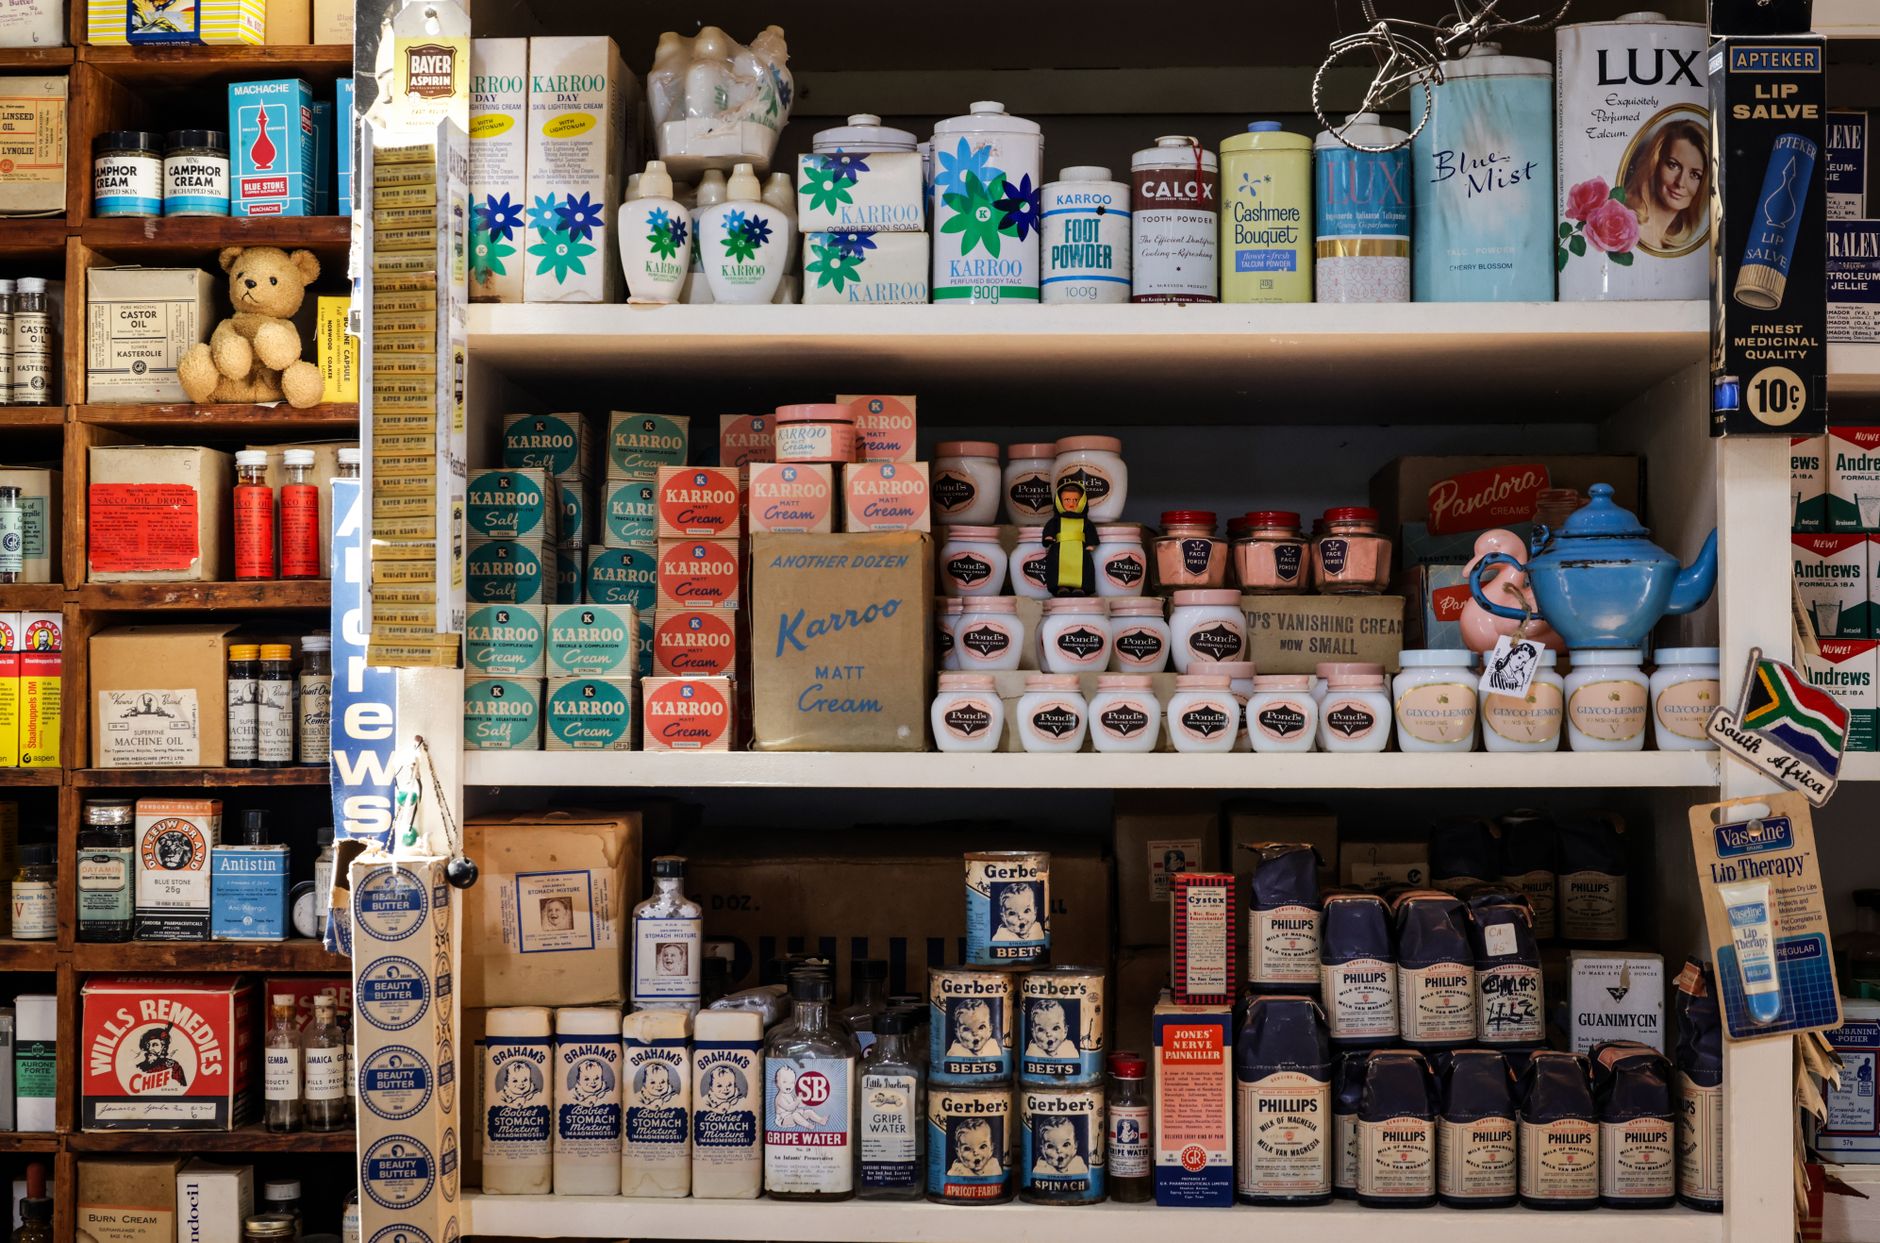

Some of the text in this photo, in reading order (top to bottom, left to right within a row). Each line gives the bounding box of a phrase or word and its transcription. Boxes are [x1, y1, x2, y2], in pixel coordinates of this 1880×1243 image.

[410, 55, 451, 74] BAYER
[1736, 52, 1815, 67] APTEKER
[1596, 48, 1704, 88] LUX
[234, 82, 289, 95] MACHACHE
[410, 76, 450, 86] ASPIRIN
[532, 74, 606, 94] KARROO
[557, 93, 579, 102] DAY
[1755, 83, 1799, 99] LIP
[1604, 92, 1659, 108] Exquisitely
[1590, 108, 1641, 124] Perfumed
[1732, 104, 1819, 120] SALVE
[2, 122, 15, 132] OIL
[558, 117, 575, 127] WITH
[1774, 135, 1818, 161] APTEKER
[168, 165, 222, 178] CAMPHOR
[1430, 150, 1511, 183] Blue
[174, 176, 214, 189] CREAM
[243, 181, 286, 191] BLUE STONE
[1327, 160, 1404, 206] LUX
[1467, 160, 1538, 199] Mist
[1141, 180, 1214, 200] CALOX
[1056, 194, 1112, 206] KARROO
[840, 204, 919, 225] KARROO
[1233, 200, 1300, 223] Cashmere
[1142, 215, 1213, 225] TOOTH POWDER
[1064, 218, 1102, 243] FOOT
[1234, 224, 1298, 248] Bouquet
[1051, 243, 1112, 270] POWDER
[1240, 259, 1292, 268] TALCUM POWDER
[644, 260, 683, 276] KARROO
[720, 264, 766, 277] KARROO
[950, 259, 1023, 277] KARROO
[1449, 262, 1513, 272] CHERRY BLOSSOM
[1831, 281, 1869, 291] JELLIE
[973, 285, 1000, 305] 90g
[119, 310, 158, 320] CASTOR
[130, 319, 148, 329] OIL
[1750, 324, 1804, 334] FINEST
[1733, 337, 1819, 347] MEDICINAL
[116, 349, 163, 359] KASTEROLIE
[1744, 349, 1808, 360] QUALITY
[754, 483, 827, 498] KARROO
[853, 480, 925, 496] KARROO
[133, 497, 152, 506] OIL
[156, 496, 189, 505] DROPS
[469, 491, 540, 506] KARROO
[665, 490, 736, 505] KARROO
[1428, 471, 1544, 530] Pandora
[863, 502, 915, 517] Cream
[1490, 505, 1531, 516] CREAMS
[676, 510, 725, 525] Cream
[1813, 539, 1839, 549] NEW!
[664, 561, 735, 576] KARROO
[770, 554, 909, 570] ANOTHER DOZEN
[952, 561, 986, 571] Pond's
[1794, 559, 1861, 579] Andrews
[674, 581, 723, 598] Cream
[775, 599, 903, 658] Karroo
[1277, 614, 1355, 634] VANISHING
[25, 619, 62, 648] LENNON
[467, 625, 539, 641] KARROO
[552, 626, 625, 642] KARROO
[969, 632, 1005, 642] Pond's
[1199, 632, 1238, 644] Pond's
[1279, 636, 1359, 655] NOW SMALL
[1822, 643, 1852, 655] NUWE!
[476, 648, 527, 664] Cream
[562, 649, 613, 665] Cream
[815, 665, 866, 680] MATT
[28, 681, 38, 697] DM
[797, 683, 883, 713] Cream
[553, 701, 625, 716] KARROO
[651, 701, 724, 716] KARROO
[951, 711, 987, 721] Pond's
[1107, 711, 1143, 721] Pond's
[563, 722, 613, 738] Cream
[662, 722, 712, 739] Cream
[114, 735, 184, 747] MACHINE OIL
[32, 752, 56, 764] aspen
[1713, 715, 1827, 796] South Africa
[220, 856, 277, 873] Antistin
[1738, 853, 1806, 880] Therapy
[164, 885, 181, 895] 25g
[1188, 895, 1225, 905] Cystex
[1270, 918, 1314, 931] PHILLIPS
[1776, 943, 1816, 957] REGULAR
[374, 981, 412, 991] BEAUTY
[941, 979, 1009, 995] Gerber's
[1022, 979, 1087, 996] Gerber's
[1424, 976, 1468, 989] PHILLIPS
[374, 990, 413, 1000] BUTTER
[1577, 1012, 1658, 1029] GUANIMYCIN
[89, 1007, 137, 1077] WILLS
[138, 998, 223, 1077] REMEDIES
[1173, 1040, 1213, 1050] NERVE
[266, 1056, 289, 1066] GEMBA
[491, 1045, 547, 1067] GRAHAM'S
[563, 1044, 618, 1065] GRAHAM'S
[1164, 1050, 1221, 1060] PAINKILLER
[949, 1062, 998, 1074] BEETS
[1026, 1063, 1075, 1076] BEETS
[128, 1068, 172, 1095] CHIEF
[796, 1076, 828, 1103] SB
[941, 1097, 1009, 1113] Gerber's
[1027, 1095, 1095, 1112] Gerber's
[1258, 1098, 1319, 1113] PHILLIPS
[565, 1113, 616, 1125] STOMACH
[872, 1113, 904, 1124] GRIPE
[869, 1123, 907, 1134] WATER
[767, 1132, 842, 1145] GRIPE WATER
[1624, 1131, 1669, 1143] PHILLIPS
[1034, 1179, 1087, 1193] SPINACH
[88, 1213, 158, 1226] BURN CREAM
